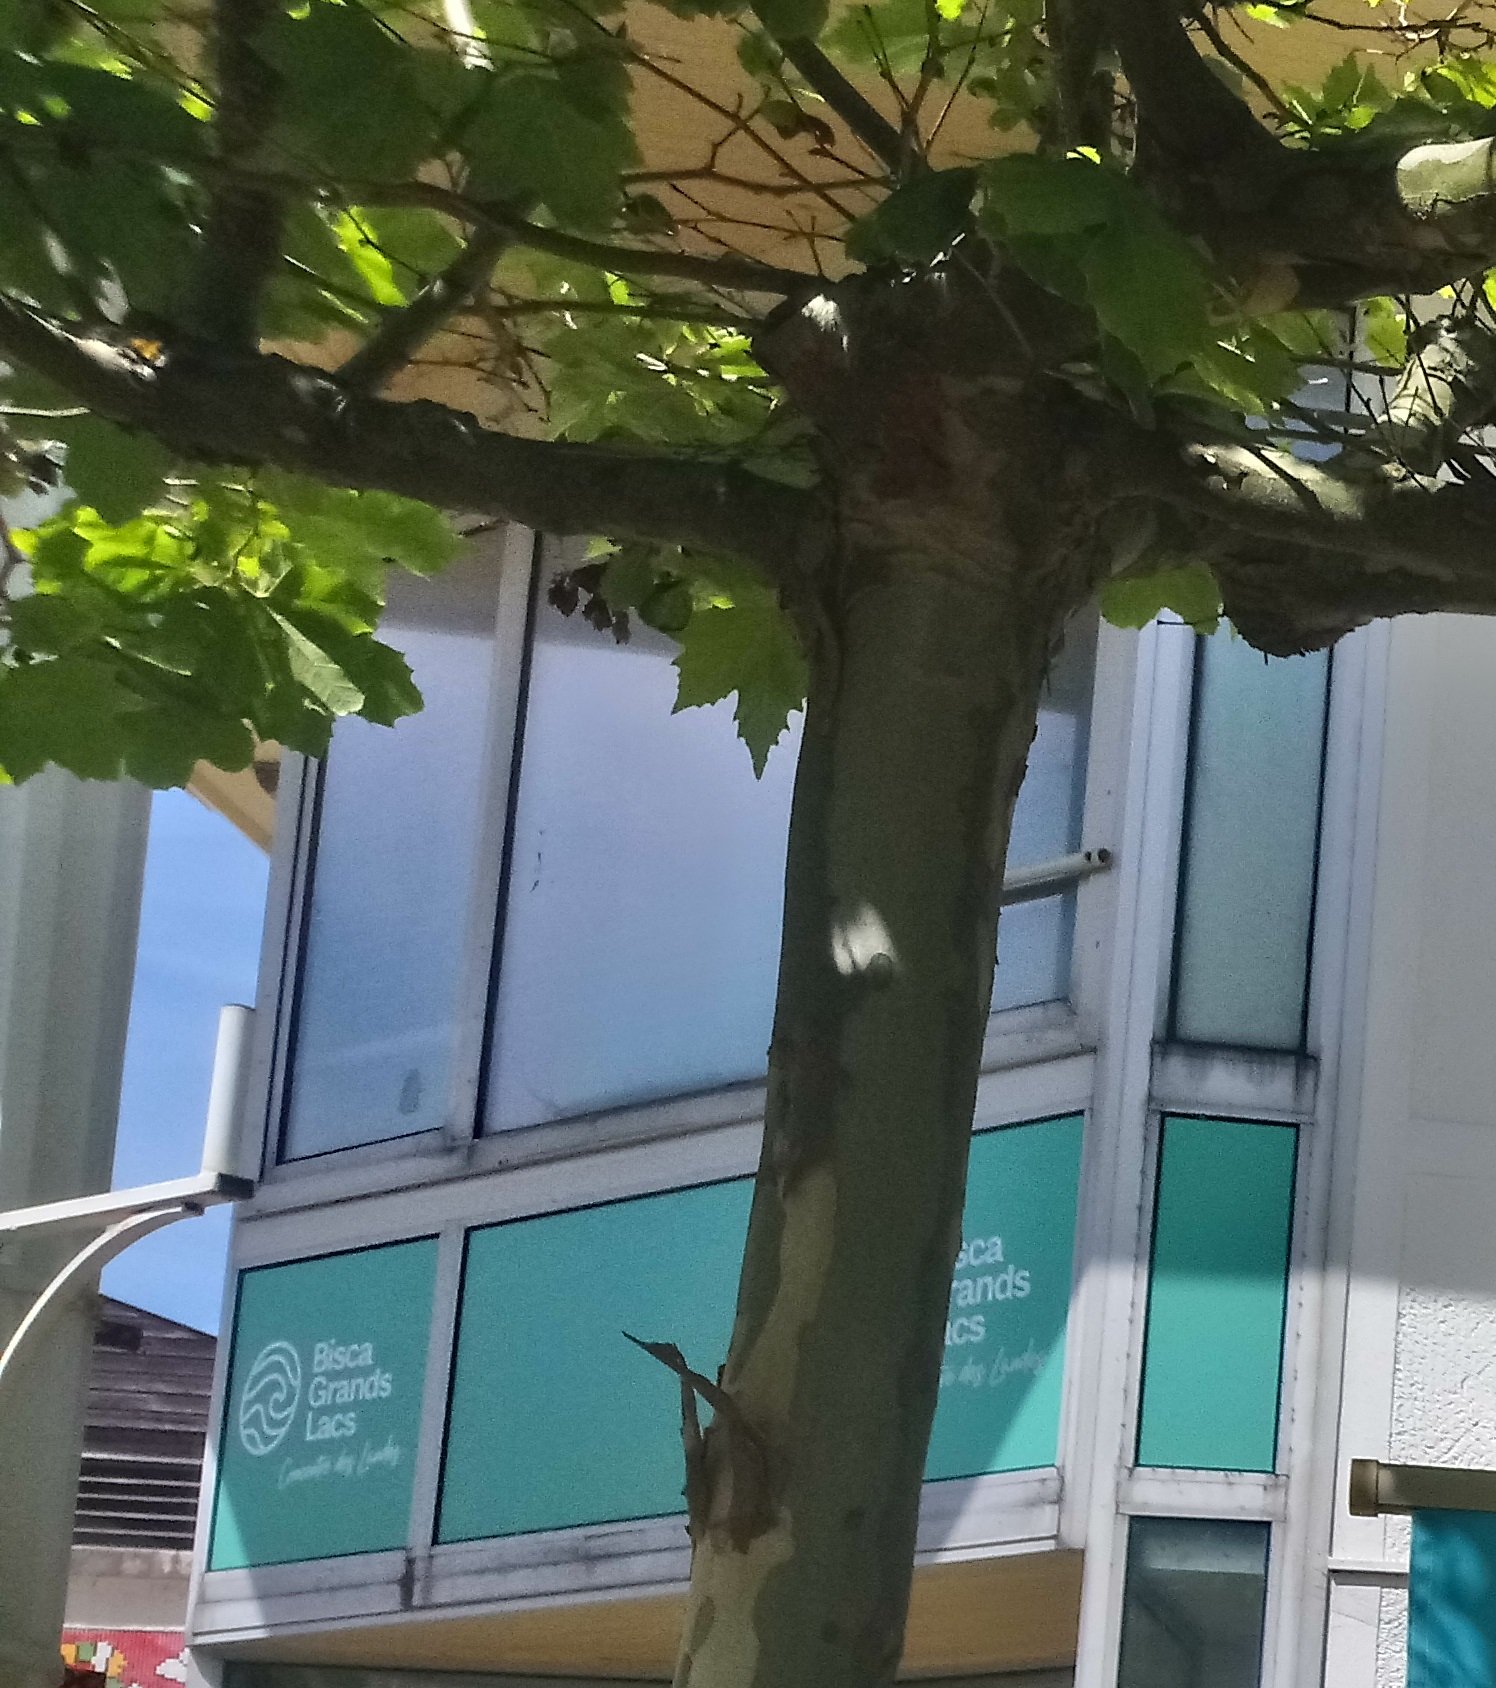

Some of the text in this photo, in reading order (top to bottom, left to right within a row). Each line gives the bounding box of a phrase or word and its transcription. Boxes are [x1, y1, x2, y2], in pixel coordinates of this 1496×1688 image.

[951, 1264, 1031, 1307] rands
[313, 1338, 374, 1373] Bisca
[308, 1368, 393, 1408] Grands
[305, 1411, 356, 1441] Lacs
